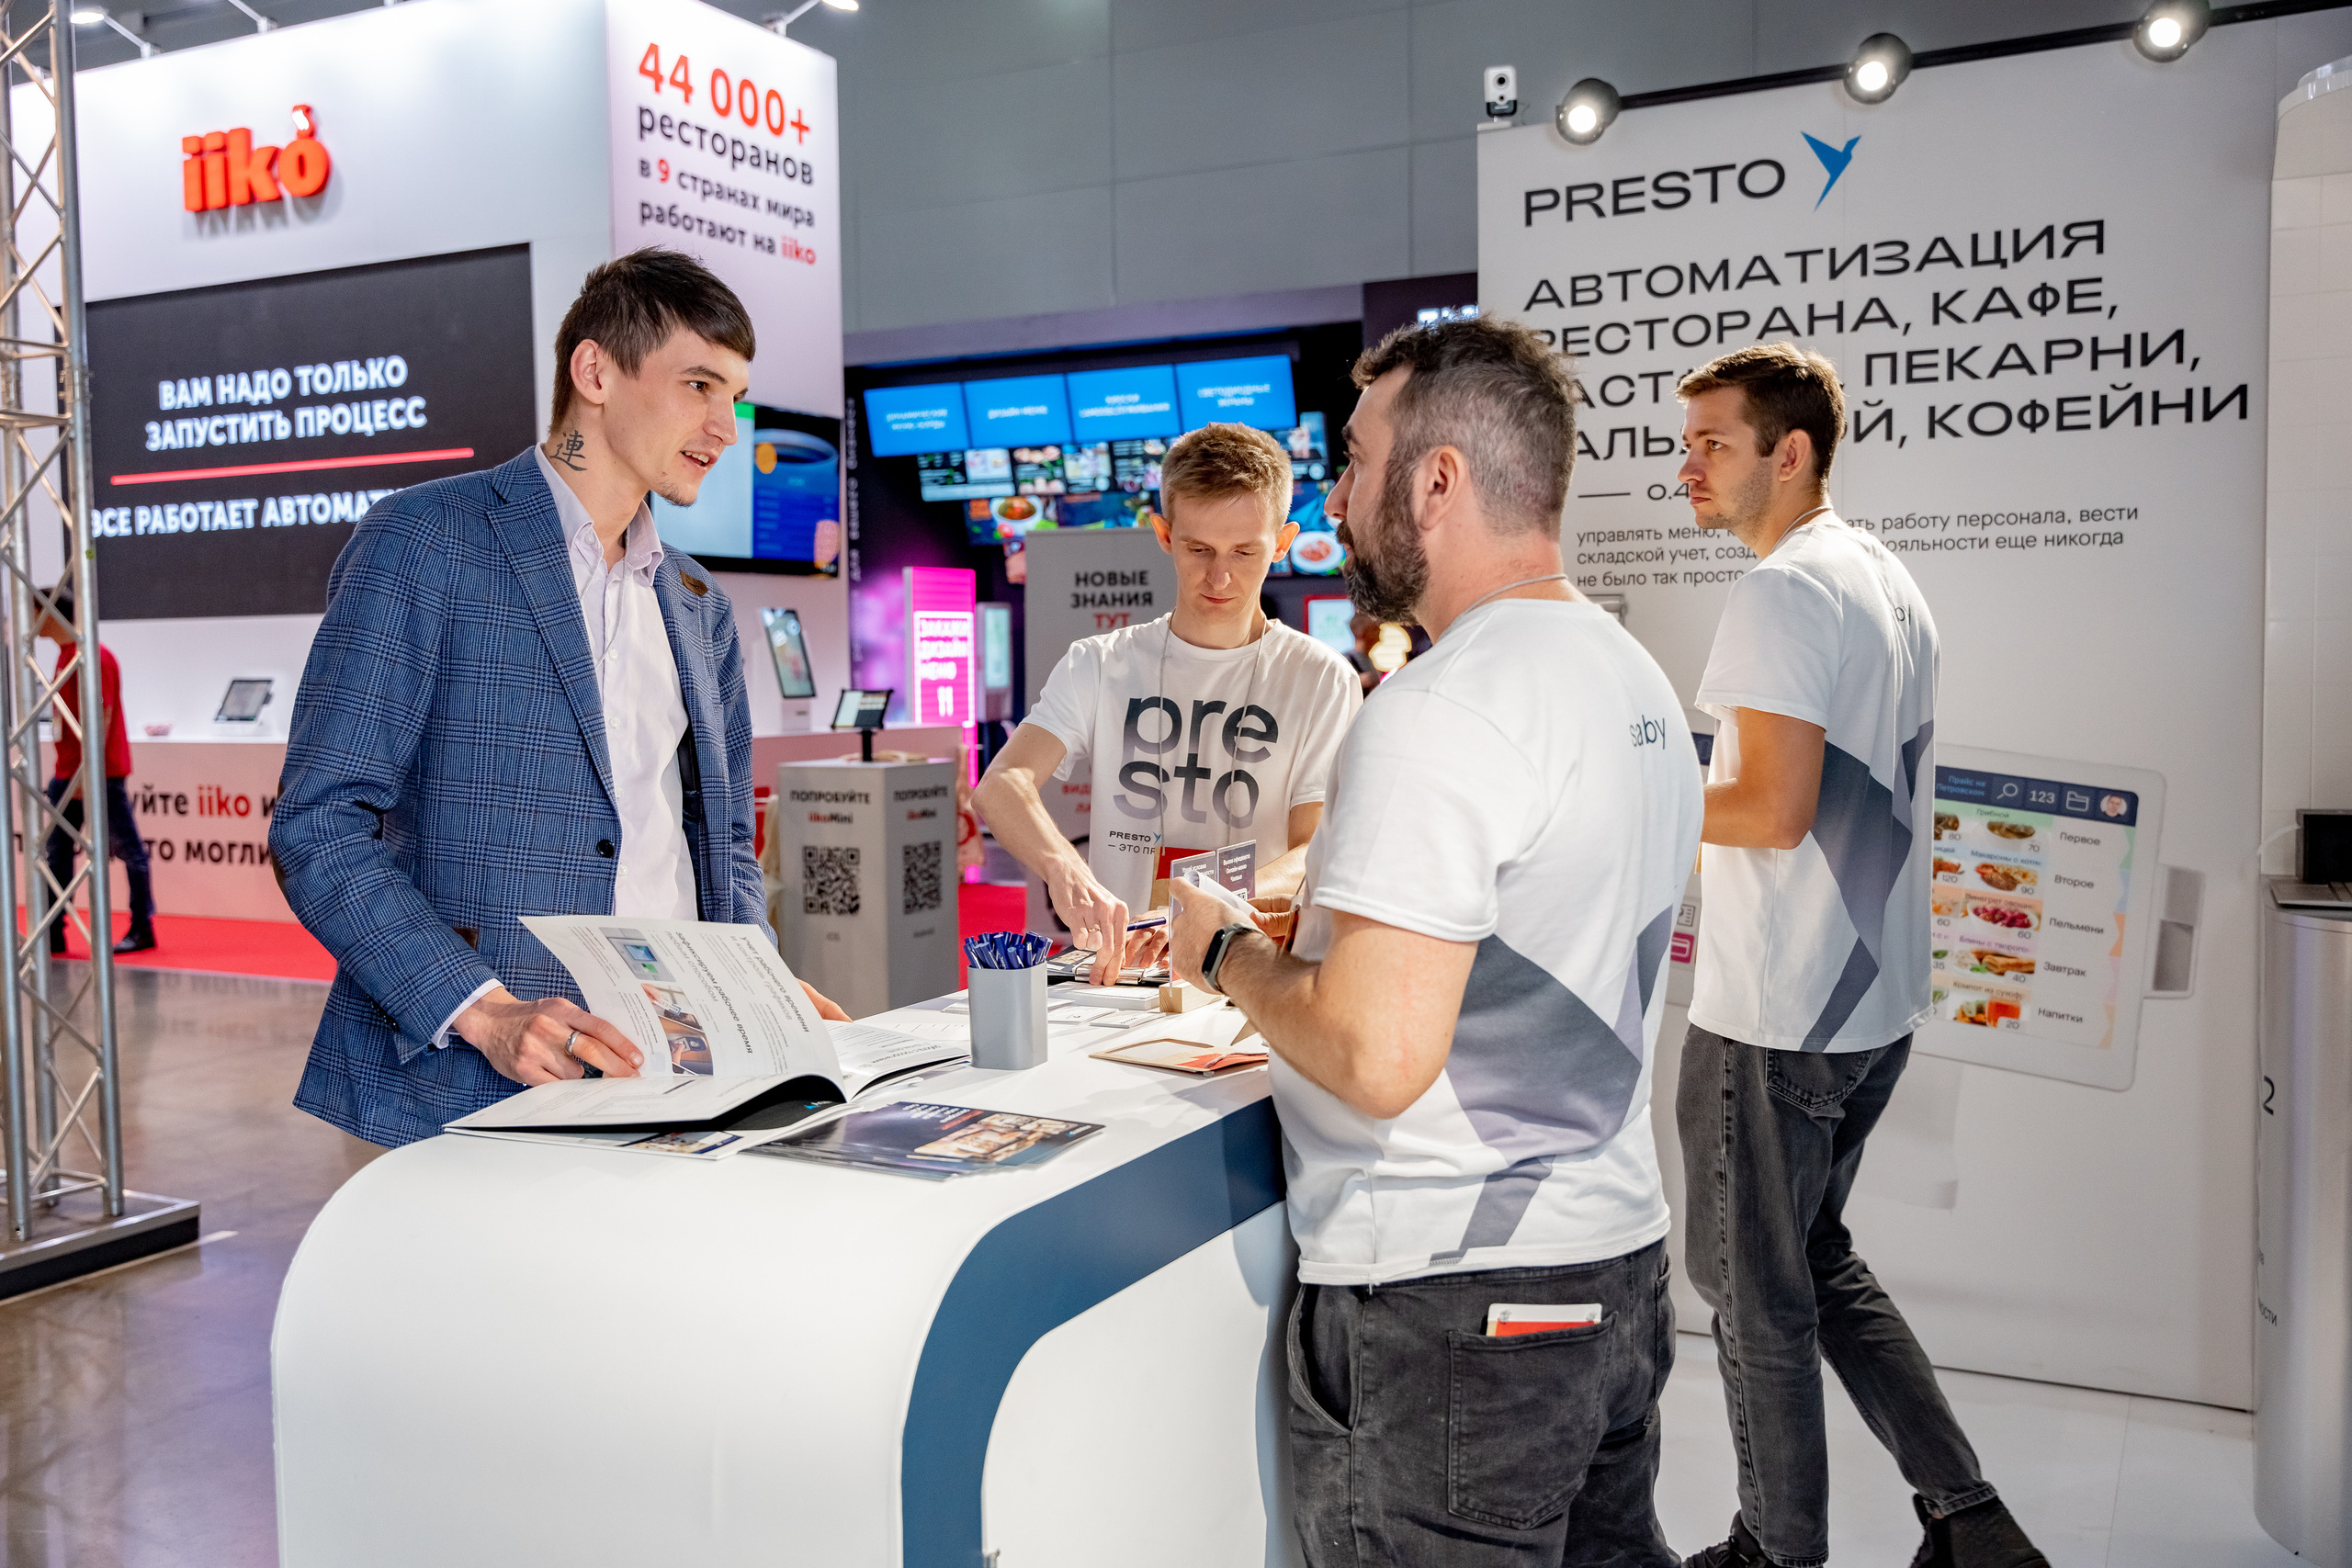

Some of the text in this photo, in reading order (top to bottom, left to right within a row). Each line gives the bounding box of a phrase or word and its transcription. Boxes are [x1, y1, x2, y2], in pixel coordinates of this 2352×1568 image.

[639, 42, 810, 143] 44 000+
[638, 105, 813, 185] ресторанов
[182, 105, 331, 212] iiko
[639, 158, 814, 229] в 9 странах мира
[1524, 159, 1785, 227] PRESTO
[640, 200, 816, 265] работают на iiko
[1523, 219, 2105, 311] АВТОМАТИЗАЦИЯ
[1932, 277, 2117, 326] КАФЕ,
[1864, 328, 2200, 387] ПЕКАРНИ,
[158, 355, 408, 411] ВАМ НАДО ТОЛЬКО
[1928, 382, 2248, 439] КОФЕЙНИ
[144, 396, 427, 451] ЗАПУСТИТЬ ПРОЦЕСС
[92, 506, 131, 537] ВСЕ
[134, 498, 259, 536] РАБОТАЕТ
[1882, 512, 1951, 534] работу
[1956, 510, 2072, 530] персонала,
[2079, 506, 2139, 523] вести
[1577, 527, 1663, 547] управлять
[1996, 534, 2037, 550] еще
[2043, 530, 2123, 547] никогда
[1577, 548, 1664, 565] складской
[1669, 547, 1709, 564] учет,
[1075, 570, 1148, 587] НОВЫЕ
[1577, 570, 1744, 587] не было так просто
[1070, 591, 1153, 609] ЗНАНИЯ
[1092, 612, 1131, 629] ТУТ
[1121, 696, 1278, 768] pre
[1629, 714, 1666, 750] saby
[789, 789, 871, 805] ПОПРОБУЙТЕ
[1114, 753, 1259, 829] sto
[2030, 790, 2055, 805] 123
[198, 785, 251, 818] iiko
[1109, 830, 1151, 842] PRESTO
[1949, 832, 1962, 841] 80
[2060, 831, 2101, 846] Первое
[1119, 843, 1140, 854] ЭТО
[2028, 843, 2040, 853] 70
[1941, 874, 1958, 884] 120
[2054, 874, 2095, 889] Второе
[2020, 887, 2034, 896] 90
[1937, 919, 1950, 927] 60
[2049, 918, 2104, 935] Пельмени
[2018, 931, 2031, 940] 60
[2012, 975, 2026, 983] 40
[2043, 961, 2086, 977] Завтрак
[687, 960, 719, 1002] способом
[741, 936, 759, 955] учет
[754, 956, 786, 993] рабочего
[785, 995, 809, 1032] времени
[1953, 981, 1982, 992] Компот
[675, 931, 718, 985] зафиксируем
[714, 985, 741, 1022] рабочее
[737, 1022, 753, 1054] время
[764, 981, 793, 1021] графиков
[2006, 1021, 2019, 1030] 20
[2038, 1008, 2083, 1023] Напитки
